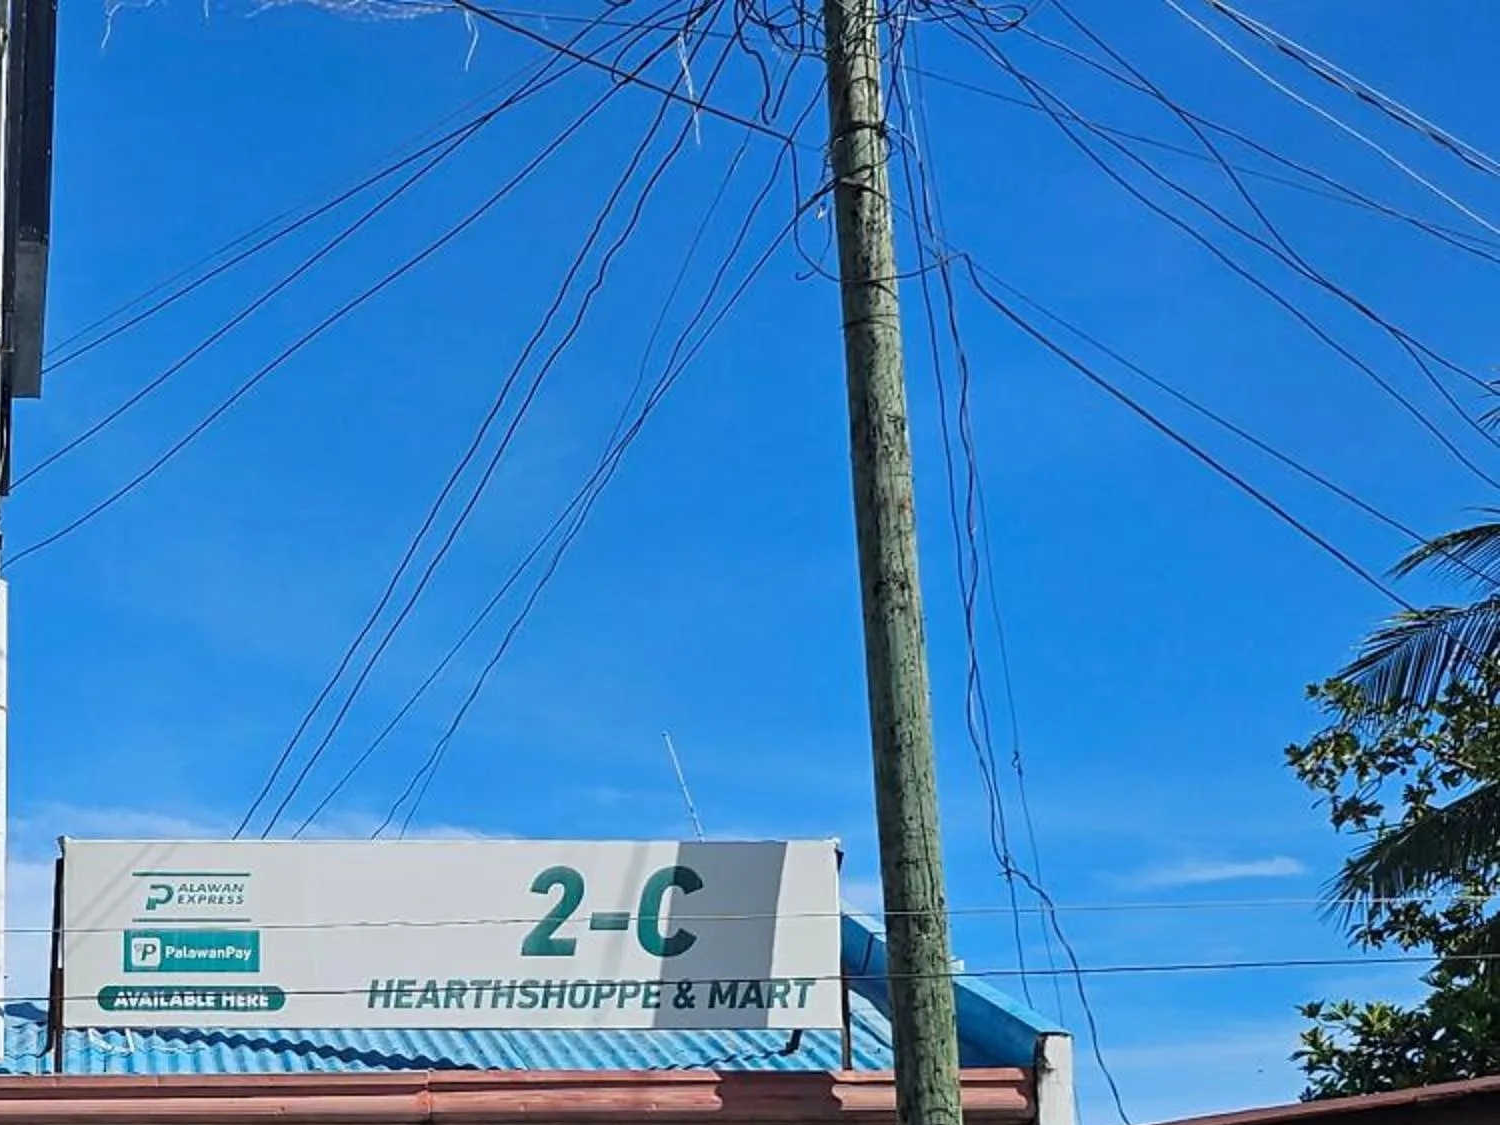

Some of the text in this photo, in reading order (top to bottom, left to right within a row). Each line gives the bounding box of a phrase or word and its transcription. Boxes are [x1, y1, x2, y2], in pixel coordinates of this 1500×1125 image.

[177, 894, 245, 905] EXPRESS
[521, 865, 704, 957] 2-C
[165, 945, 251, 961] PalawanPay
[113, 991, 269, 1007] AVAILABLE HERE
[367, 978, 817, 1009] HEARTHSHOPPE & MART
